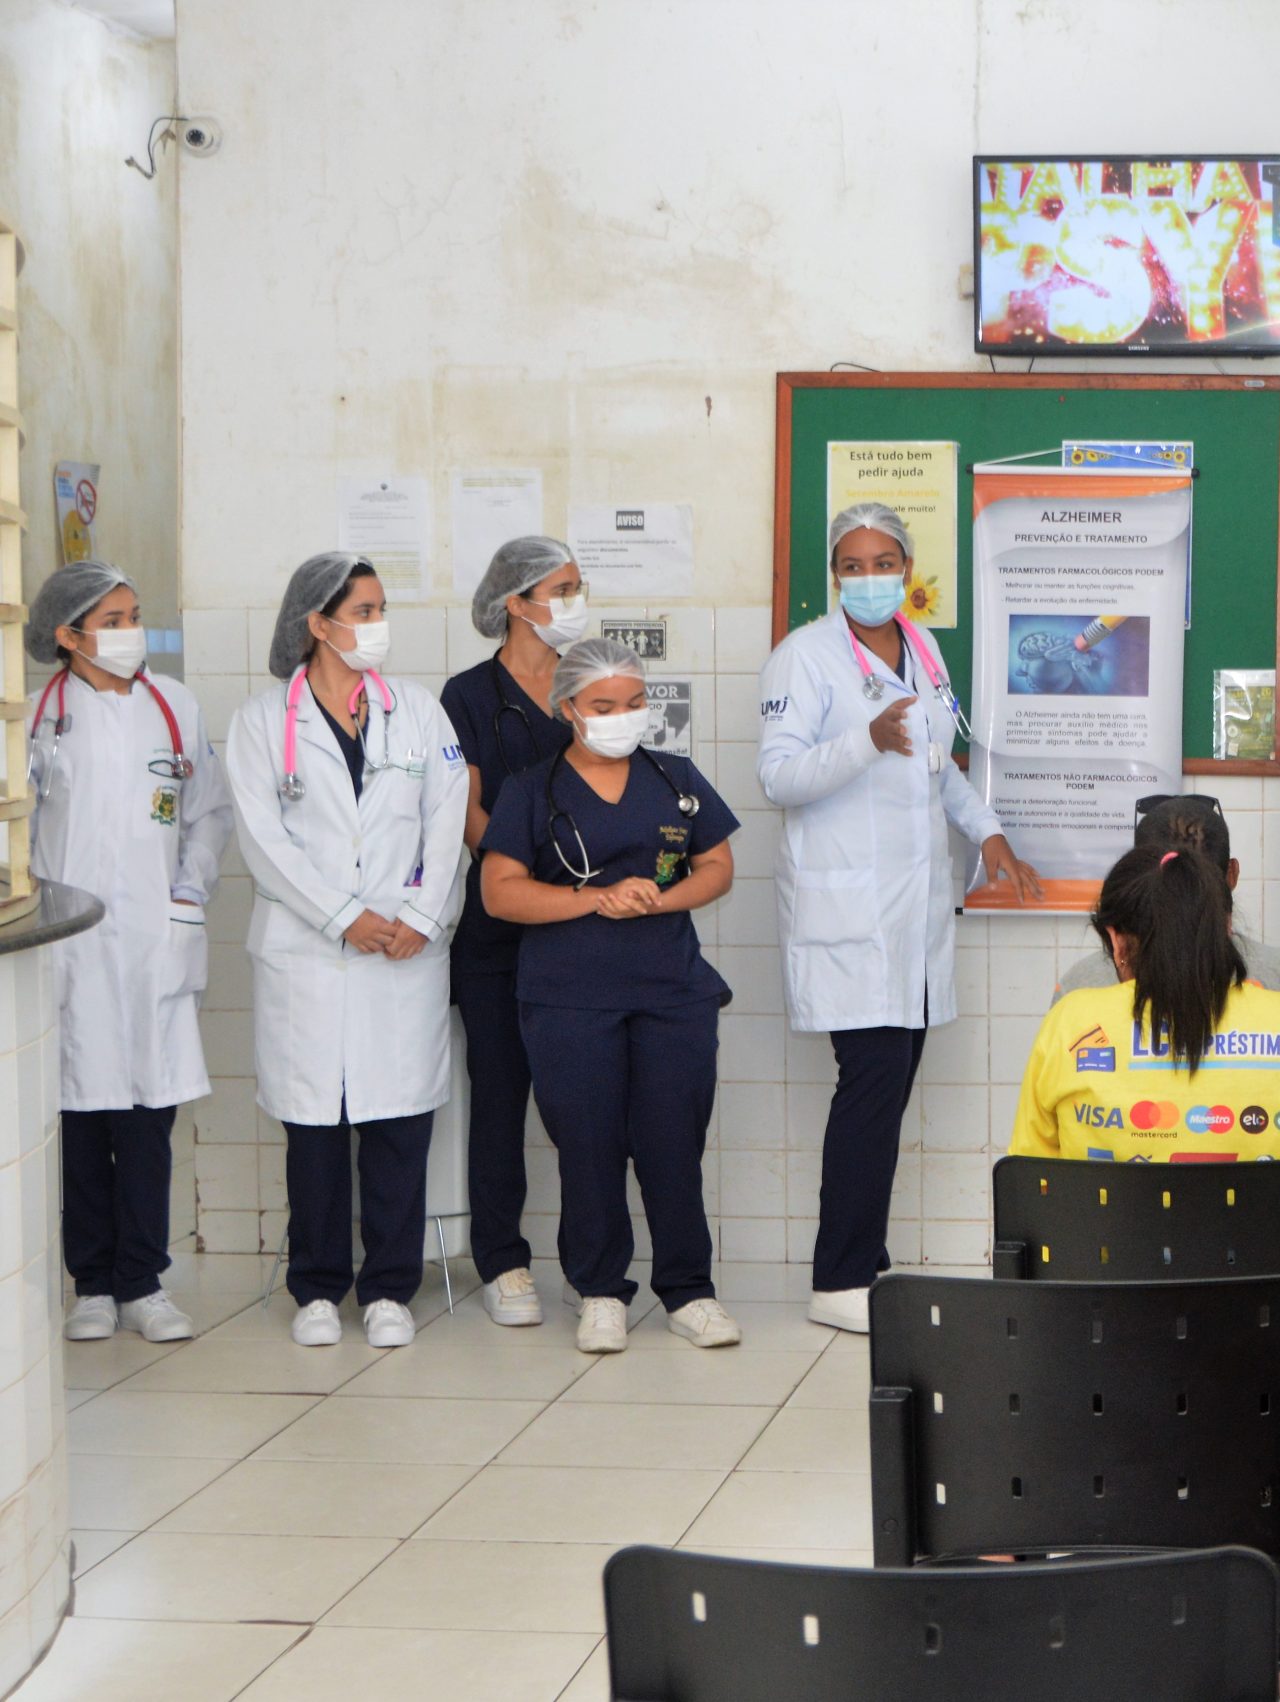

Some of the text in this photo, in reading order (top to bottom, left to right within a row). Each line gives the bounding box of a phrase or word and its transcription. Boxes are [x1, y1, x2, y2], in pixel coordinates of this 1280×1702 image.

[850, 450, 932, 461] Está tudo bem
[858, 467, 924, 480] pedir ajuda
[908, 505, 936, 513] muito!
[617, 514, 644, 527] AVISO
[1041, 511, 1122, 523] ALZHEIMER
[1014, 533, 1148, 544] PREVENÇÃO E TRATAMENTO
[998, 566, 1165, 577] TRATAMENTOS FARMACOLÓGICOS PODEM
[646, 685, 678, 698] VOR
[1028, 721, 1062, 729] procurar
[1006, 729, 1042, 738] primeiros
[1088, 730, 1107, 738] pode
[1112, 731, 1137, 739] ajudar
[1046, 738, 1070, 747] alguns
[1075, 738, 1099, 746] efeitos
[1004, 772, 1158, 783] TRATAMENTOS NÃO FARMACOLÓGICOS
[1103, 824, 1136, 832] comporta
[1072, 1103, 1124, 1129] VISA
[1243, 1113, 1266, 1126] elo
[1130, 1131, 1178, 1139] mastercard
